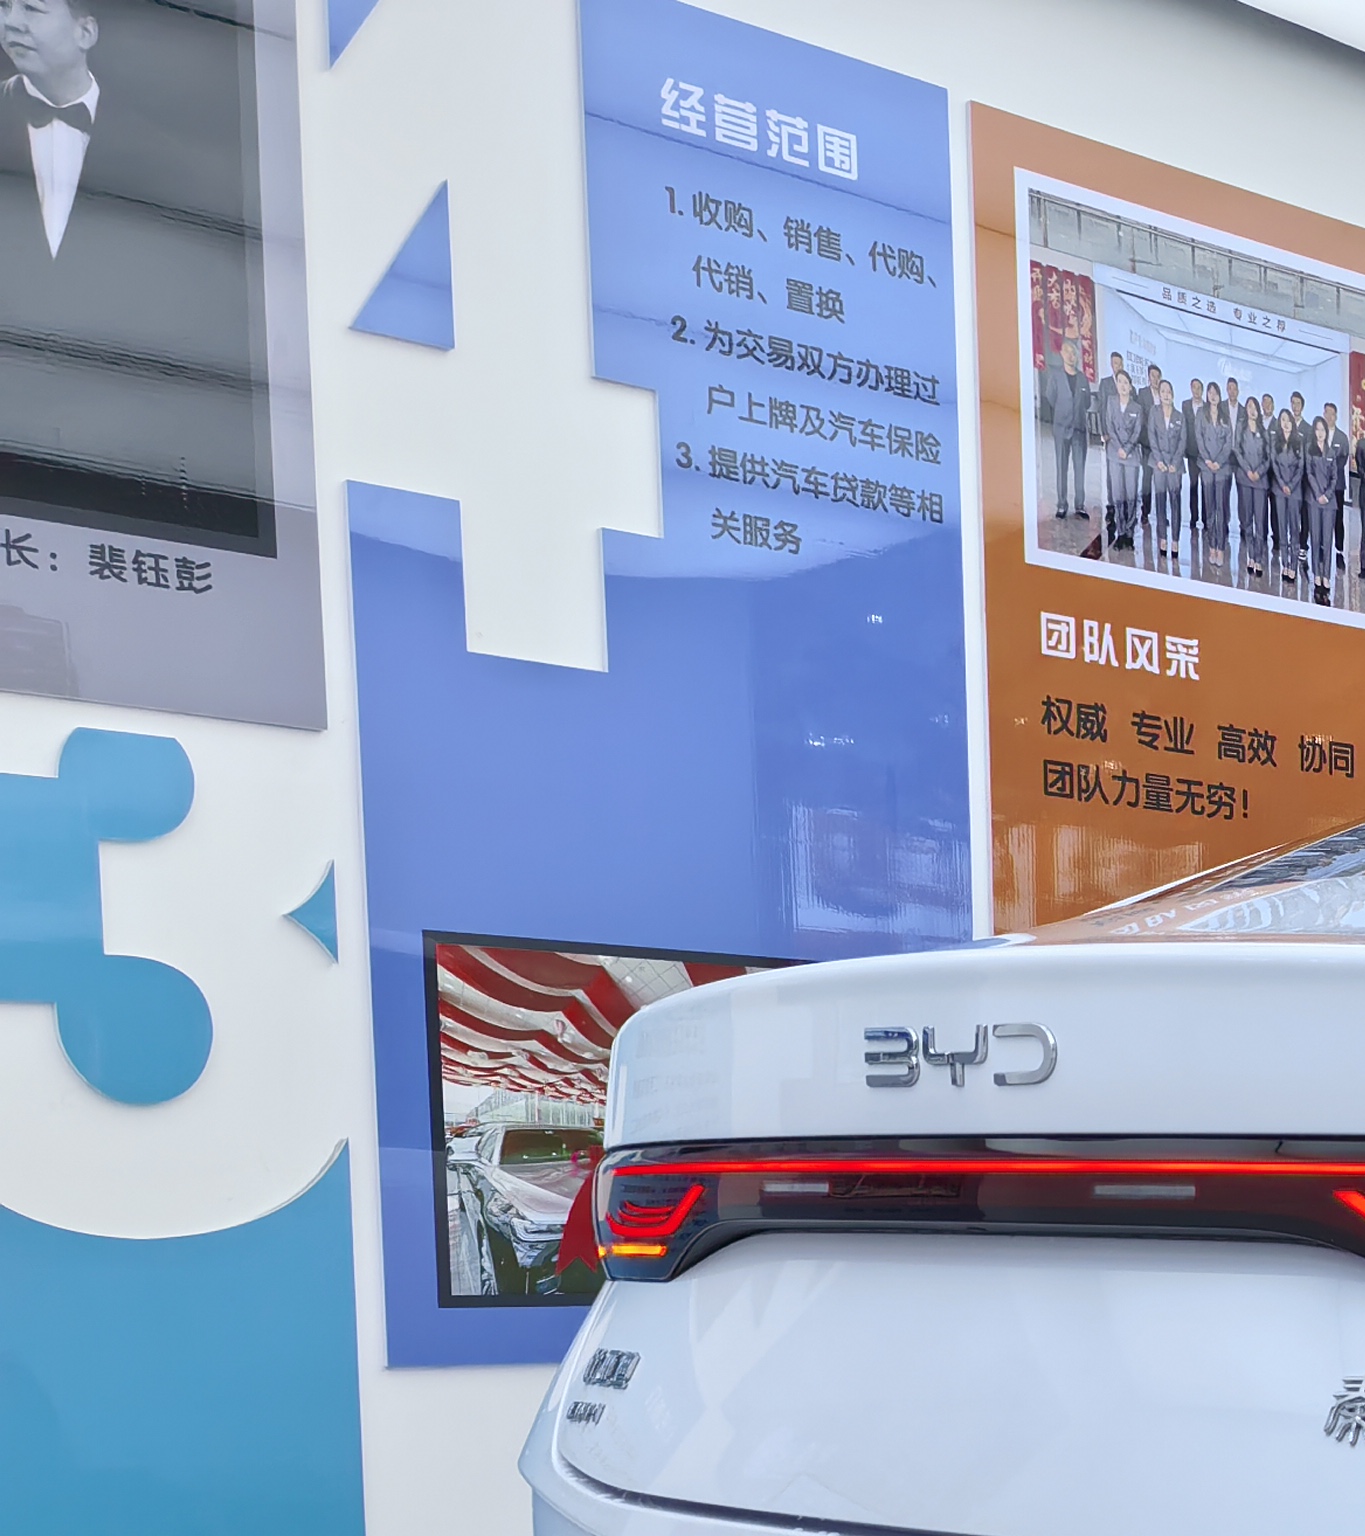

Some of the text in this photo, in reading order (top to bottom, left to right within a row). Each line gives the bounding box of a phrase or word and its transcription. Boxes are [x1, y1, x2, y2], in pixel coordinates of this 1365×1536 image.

[660, 77, 859, 181] 经营范围
[691, 254, 845, 324] 代销、置换
[706, 383, 942, 465] 户上牌及汽车保险
[710, 507, 803, 555] 关服务
[1040, 611, 1200, 681] 团队风采
[1041, 695, 1356, 779] 权威 专业 高效 协同
[863, 1021, 1058, 1088] BYD
